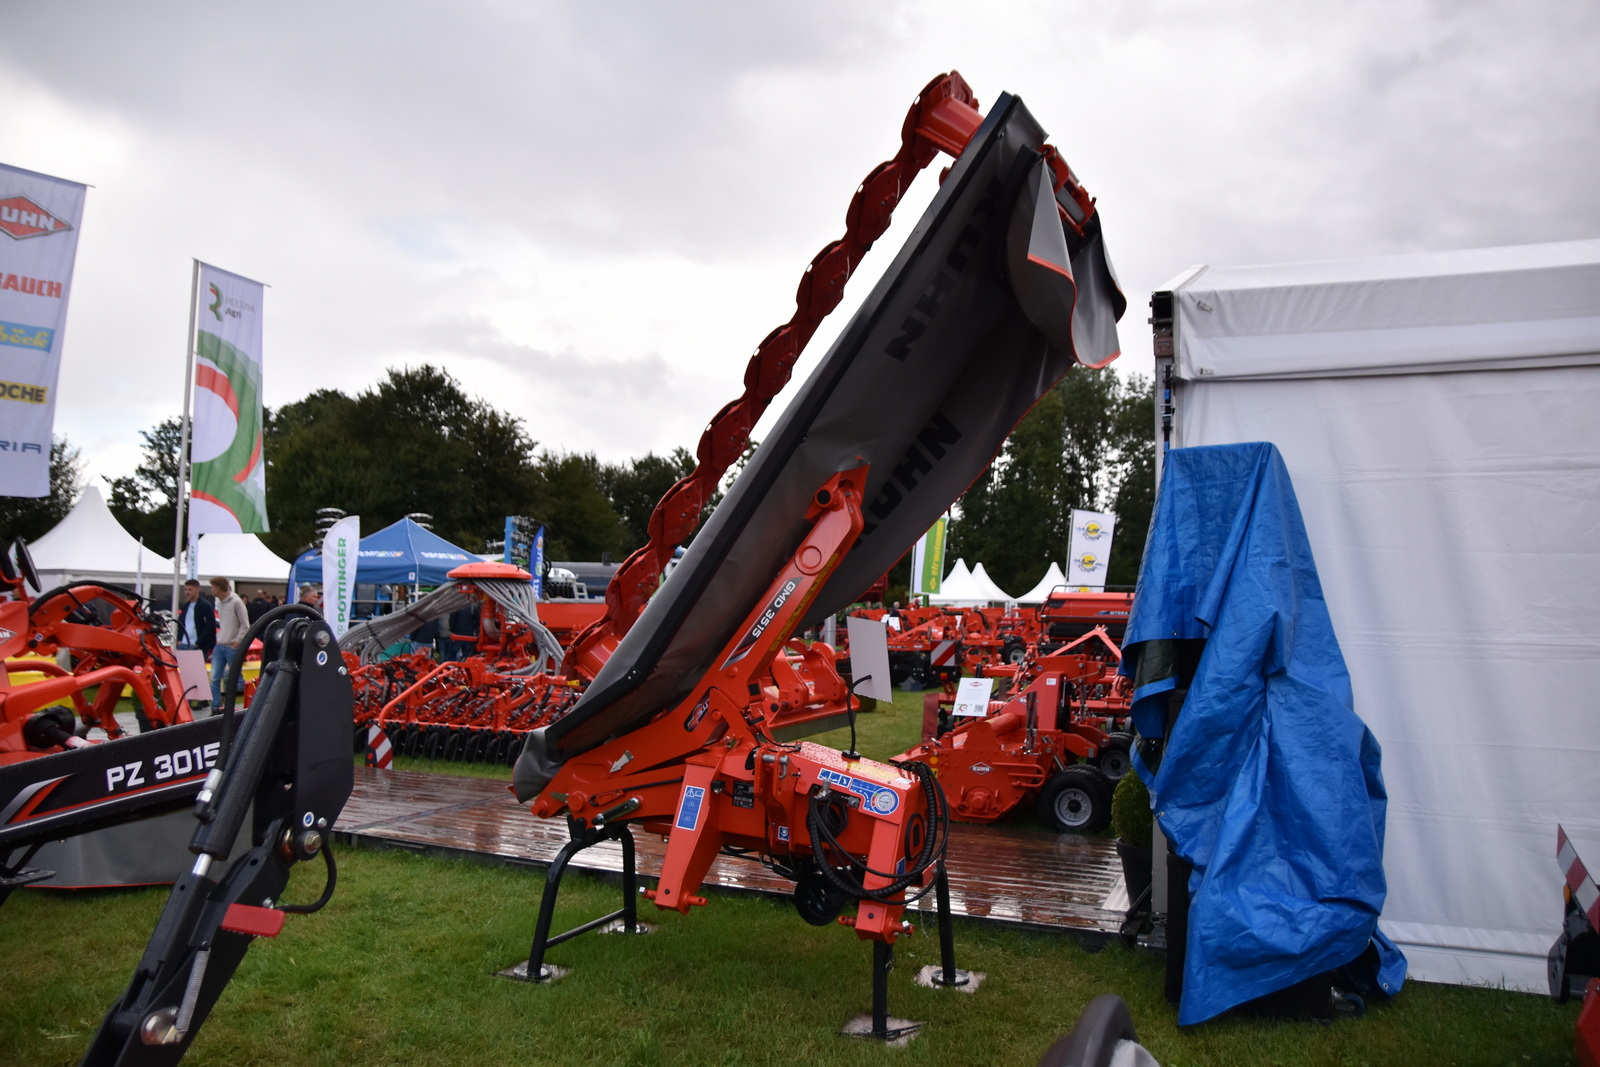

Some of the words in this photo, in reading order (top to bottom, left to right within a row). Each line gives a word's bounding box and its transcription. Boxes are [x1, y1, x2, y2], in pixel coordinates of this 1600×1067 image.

[0, 272, 62, 298] AUCH
[337, 538, 346, 623] PÖTTINGER
[774, 581, 796, 608] GMD
[752, 609, 775, 638] 3515
[106, 760, 145, 791] PZ
[154, 741, 220, 779] 3015
